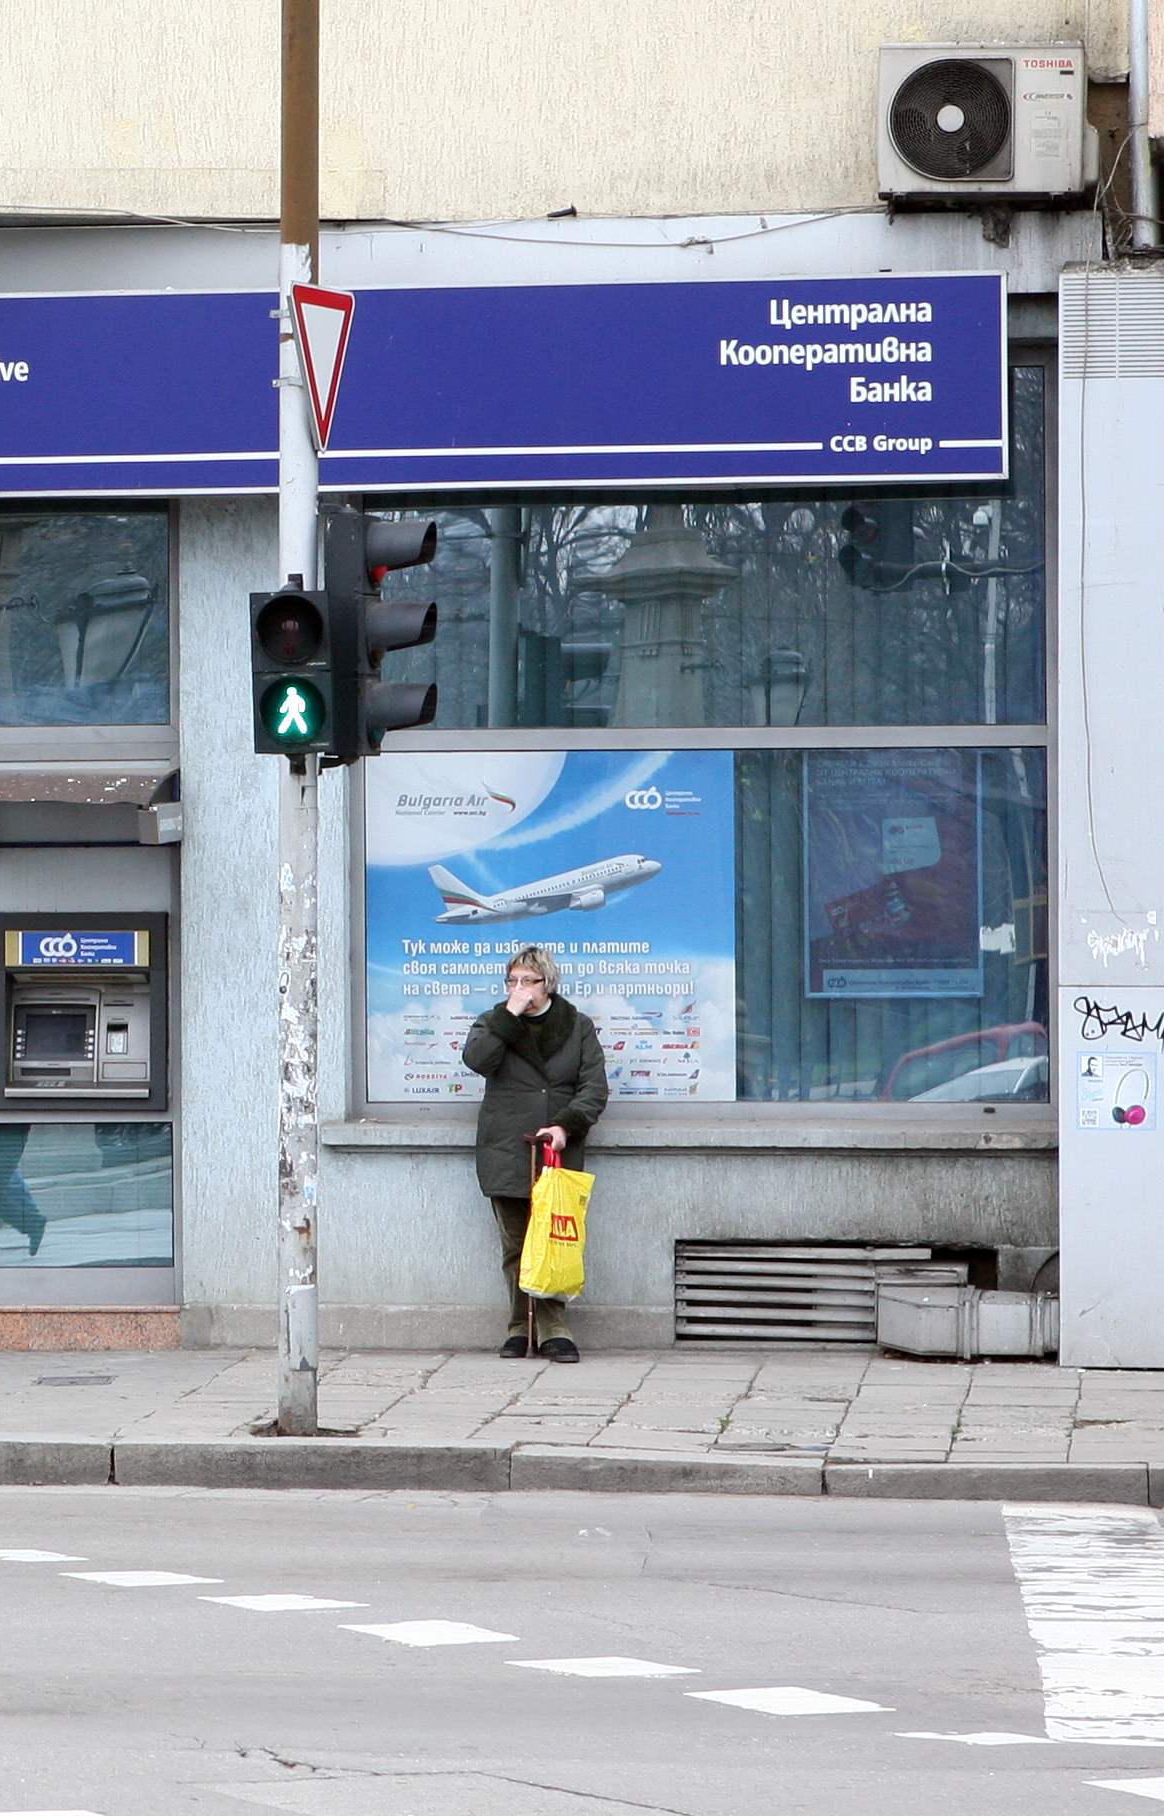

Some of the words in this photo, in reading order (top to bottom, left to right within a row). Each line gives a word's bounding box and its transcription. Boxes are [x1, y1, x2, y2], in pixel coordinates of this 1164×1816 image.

[1022, 59, 1073, 68] TOSHIBA
[770, 299, 932, 330] Централна
[719, 336, 932, 371] Кооперативна
[849, 375, 932, 403] Банка
[829, 435, 868, 452] CCB
[873, 434, 933, 454] Group
[397, 794, 464, 810] Bulgaria
[466, 794, 490, 807] Air
[402, 939, 426, 957] Тук
[430, 939, 470, 954] може
[474, 942, 491, 957] да
[570, 942, 578, 954] и
[582, 941, 650, 954] платите
[403, 960, 437, 975] своя
[577, 962, 594, 977] до
[599, 960, 640, 975] всяка
[645, 960, 690, 975] точка
[403, 983, 419, 996] на
[424, 981, 470, 996] света
[490, 983, 499, 996] с
[574, 981, 592, 998] Ер
[596, 983, 604, 995] и
[609, 981, 695, 998] партньори!
